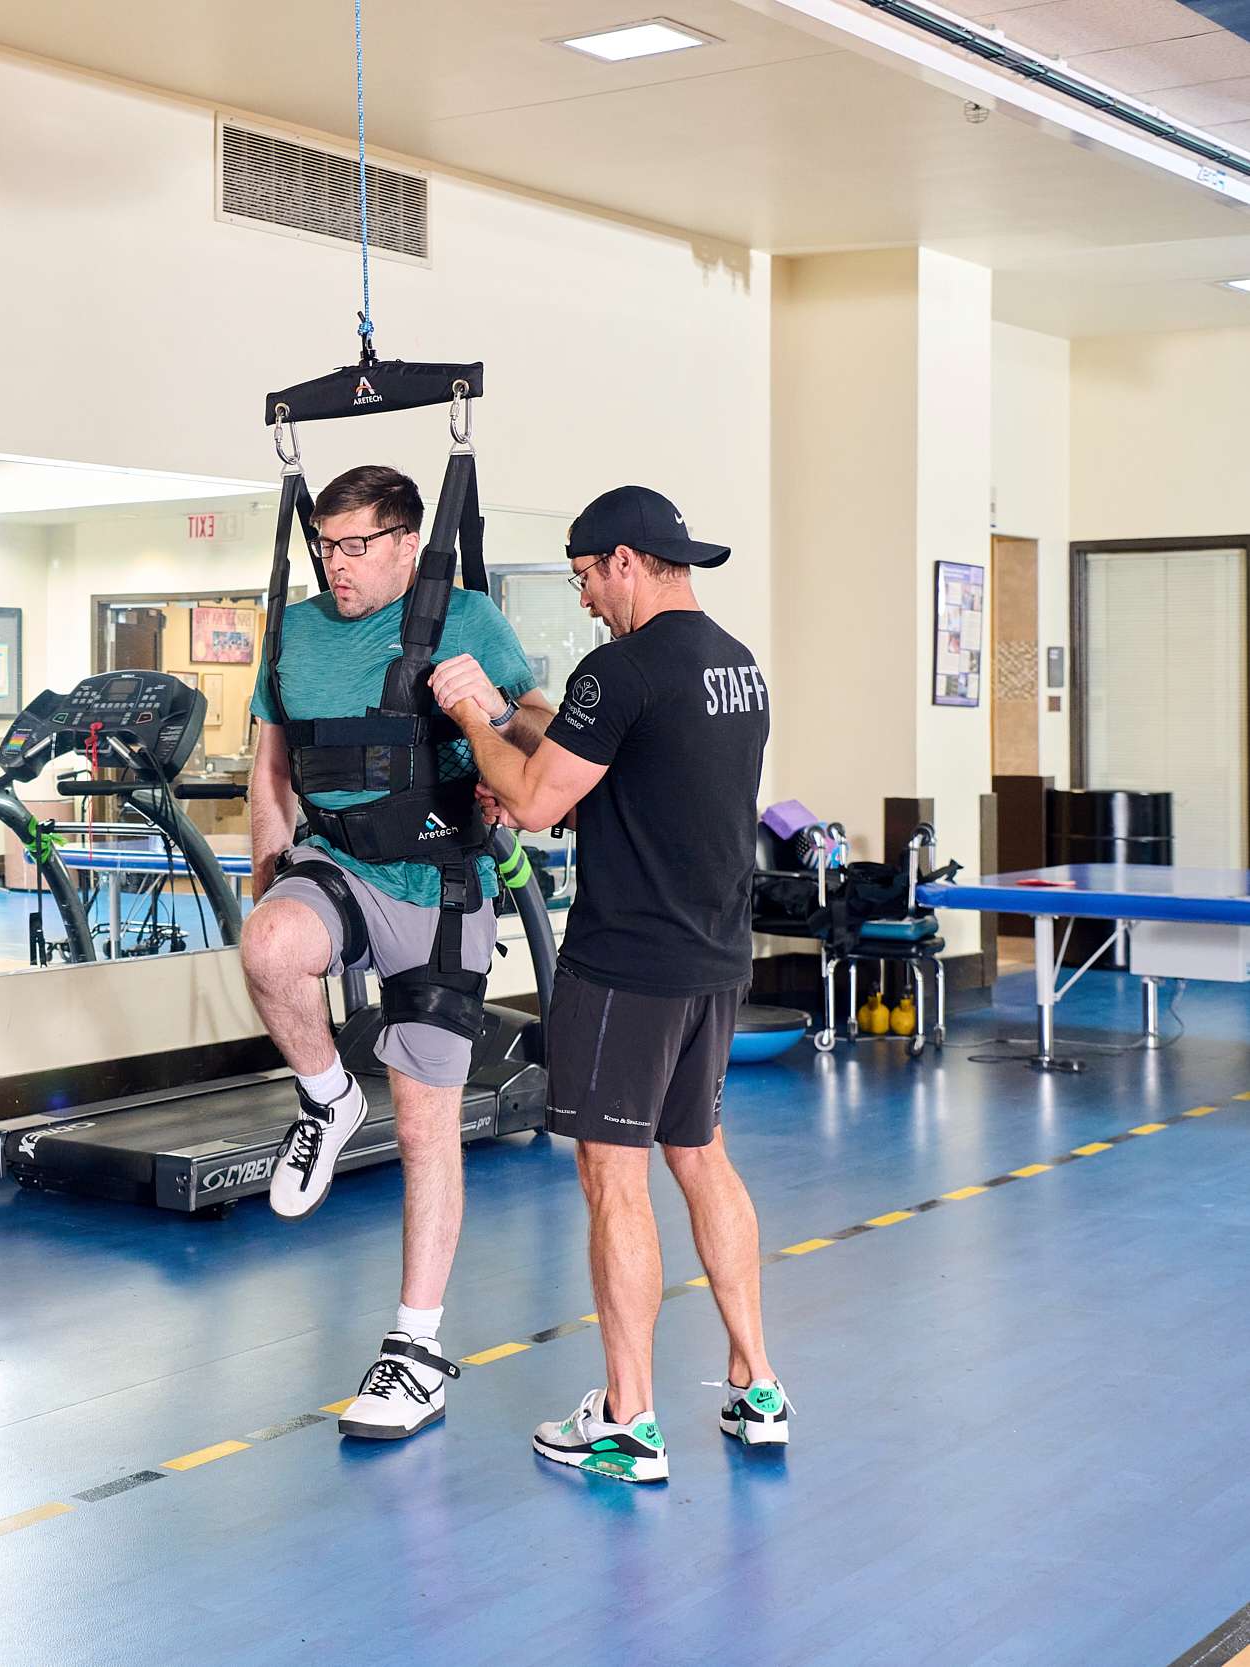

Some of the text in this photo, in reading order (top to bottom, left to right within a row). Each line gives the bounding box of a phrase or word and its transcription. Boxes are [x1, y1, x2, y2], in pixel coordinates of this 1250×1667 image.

[353, 395, 383, 405] ARETECH
[703, 665, 765, 716] STAFF
[417, 826, 459, 841] Aretech
[477, 1116, 491, 1131] pro
[225, 1156, 277, 1187] CYBEX
